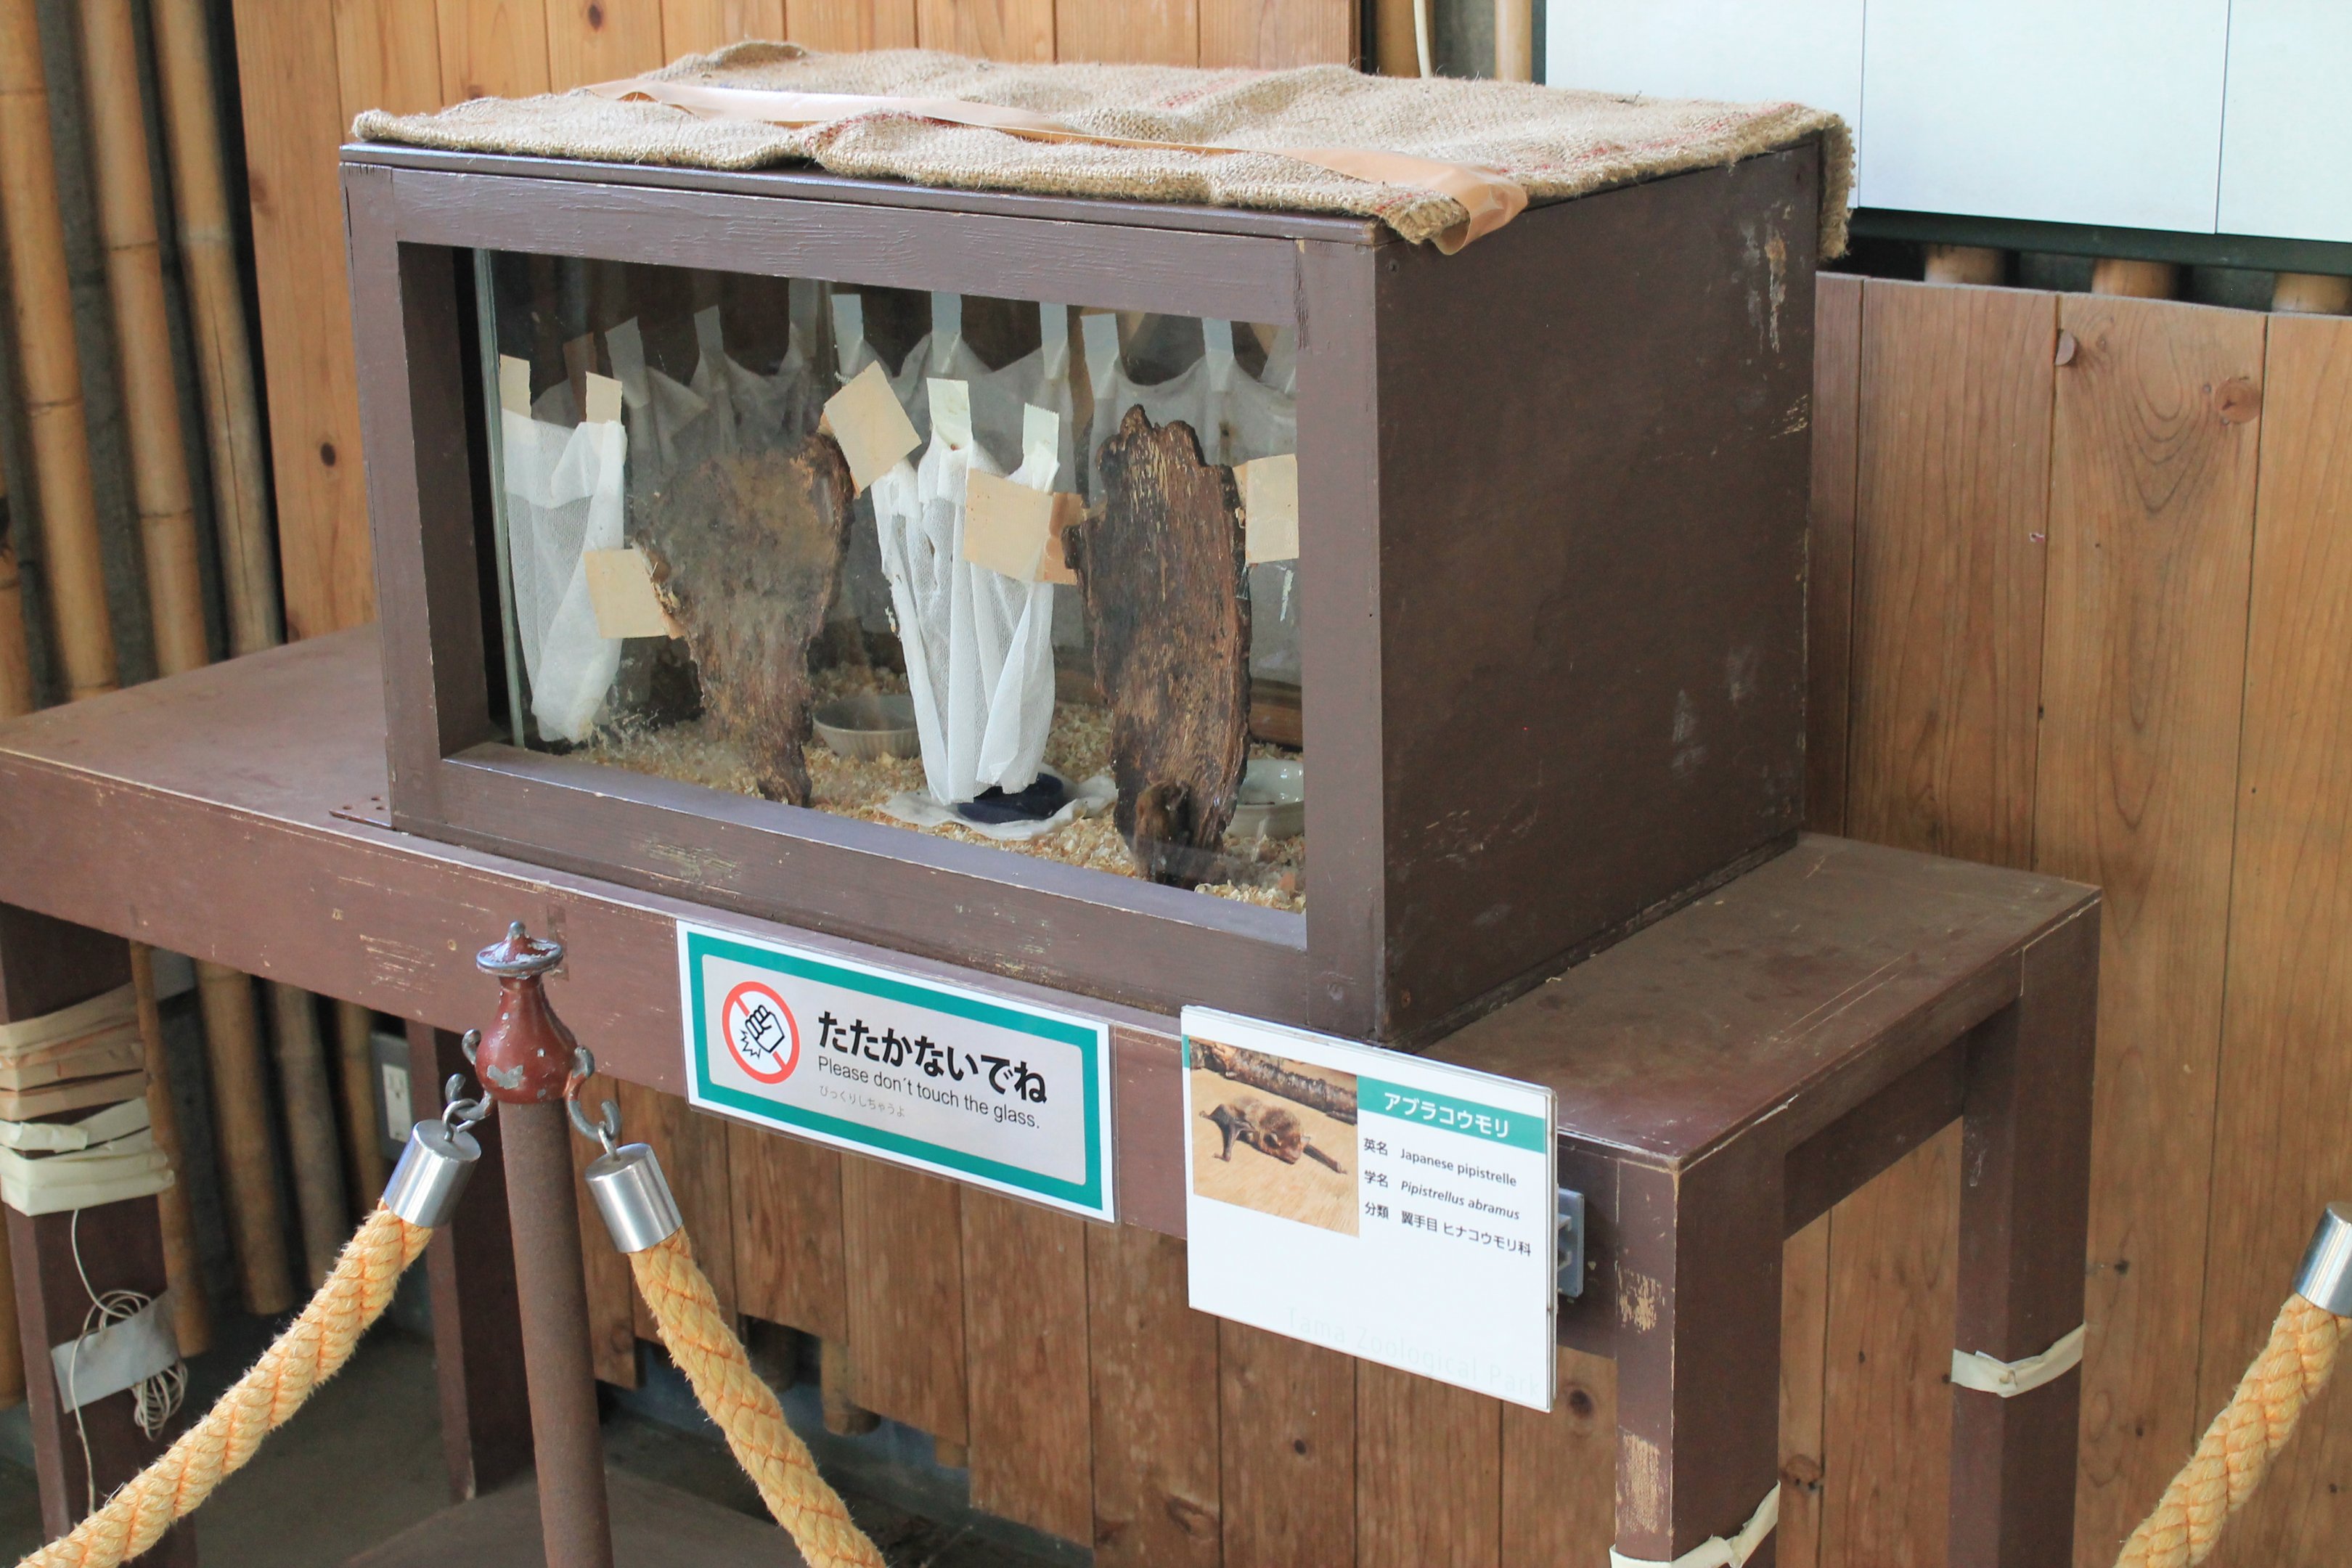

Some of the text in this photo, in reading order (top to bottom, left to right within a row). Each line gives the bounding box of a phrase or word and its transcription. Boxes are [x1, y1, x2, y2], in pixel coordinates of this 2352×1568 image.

[818, 1010, 1047, 1103] たたかないでね
[818, 1056, 868, 1083] Please
[917, 1083, 959, 1107] touch
[964, 1095, 988, 1114] the
[993, 1104, 1040, 1129] glass.
[1384, 1092, 1509, 1138] アブラコウモリ
[1363, 1138, 1388, 1156] 英名
[1400, 1148, 1516, 1186] Japanese pipistrelle
[1364, 1169, 1389, 1188] 学名
[1401, 1180, 1520, 1220] Pipistrellus abramus
[1365, 1201, 1532, 1257] 分類 翼手目 ヒナコウモリ科
[1286, 1305, 1541, 1398] Tama Zoological Park
